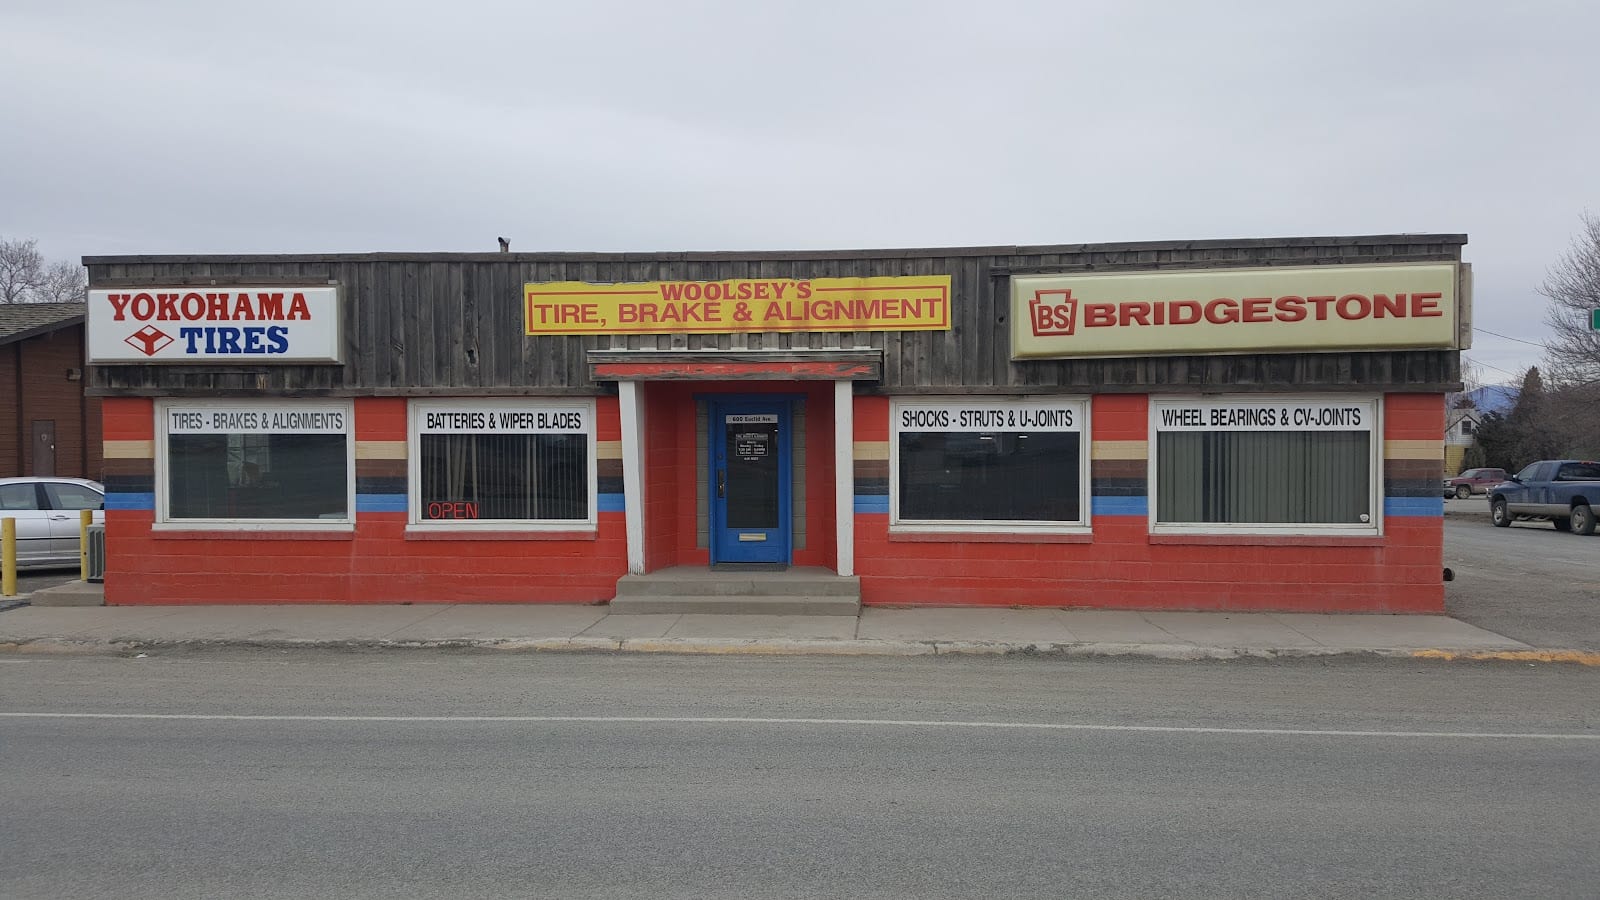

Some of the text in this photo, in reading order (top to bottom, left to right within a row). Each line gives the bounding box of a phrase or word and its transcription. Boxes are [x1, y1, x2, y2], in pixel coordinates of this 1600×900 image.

[660, 281, 812, 301] WOOLSEY'S
[108, 293, 311, 321] YOKOHAMA
[534, 298, 942, 327] TIRE, BRAKE & ALIGNMENT
[1084, 292, 1443, 328] BRIDGESTONE
[1038, 304, 1070, 331] BS
[180, 325, 289, 354] TIRES
[172, 413, 203, 430] TIRES
[213, 413, 259, 429] BRAKES
[261, 413, 269, 429] &
[272, 412, 343, 429] ALIGNMENTS
[427, 412, 582, 429] BATTERIES & WIPER BLADES
[902, 410, 949, 428] SHOCKS
[960, 410, 1004, 428] STRUTS
[1007, 410, 1016, 427] &
[1019, 409, 1073, 427] U-JOINTS
[1162, 407, 1361, 427] WHEEL BEARINGS & CV-JOINTS
[428, 502, 479, 519] OPEN
